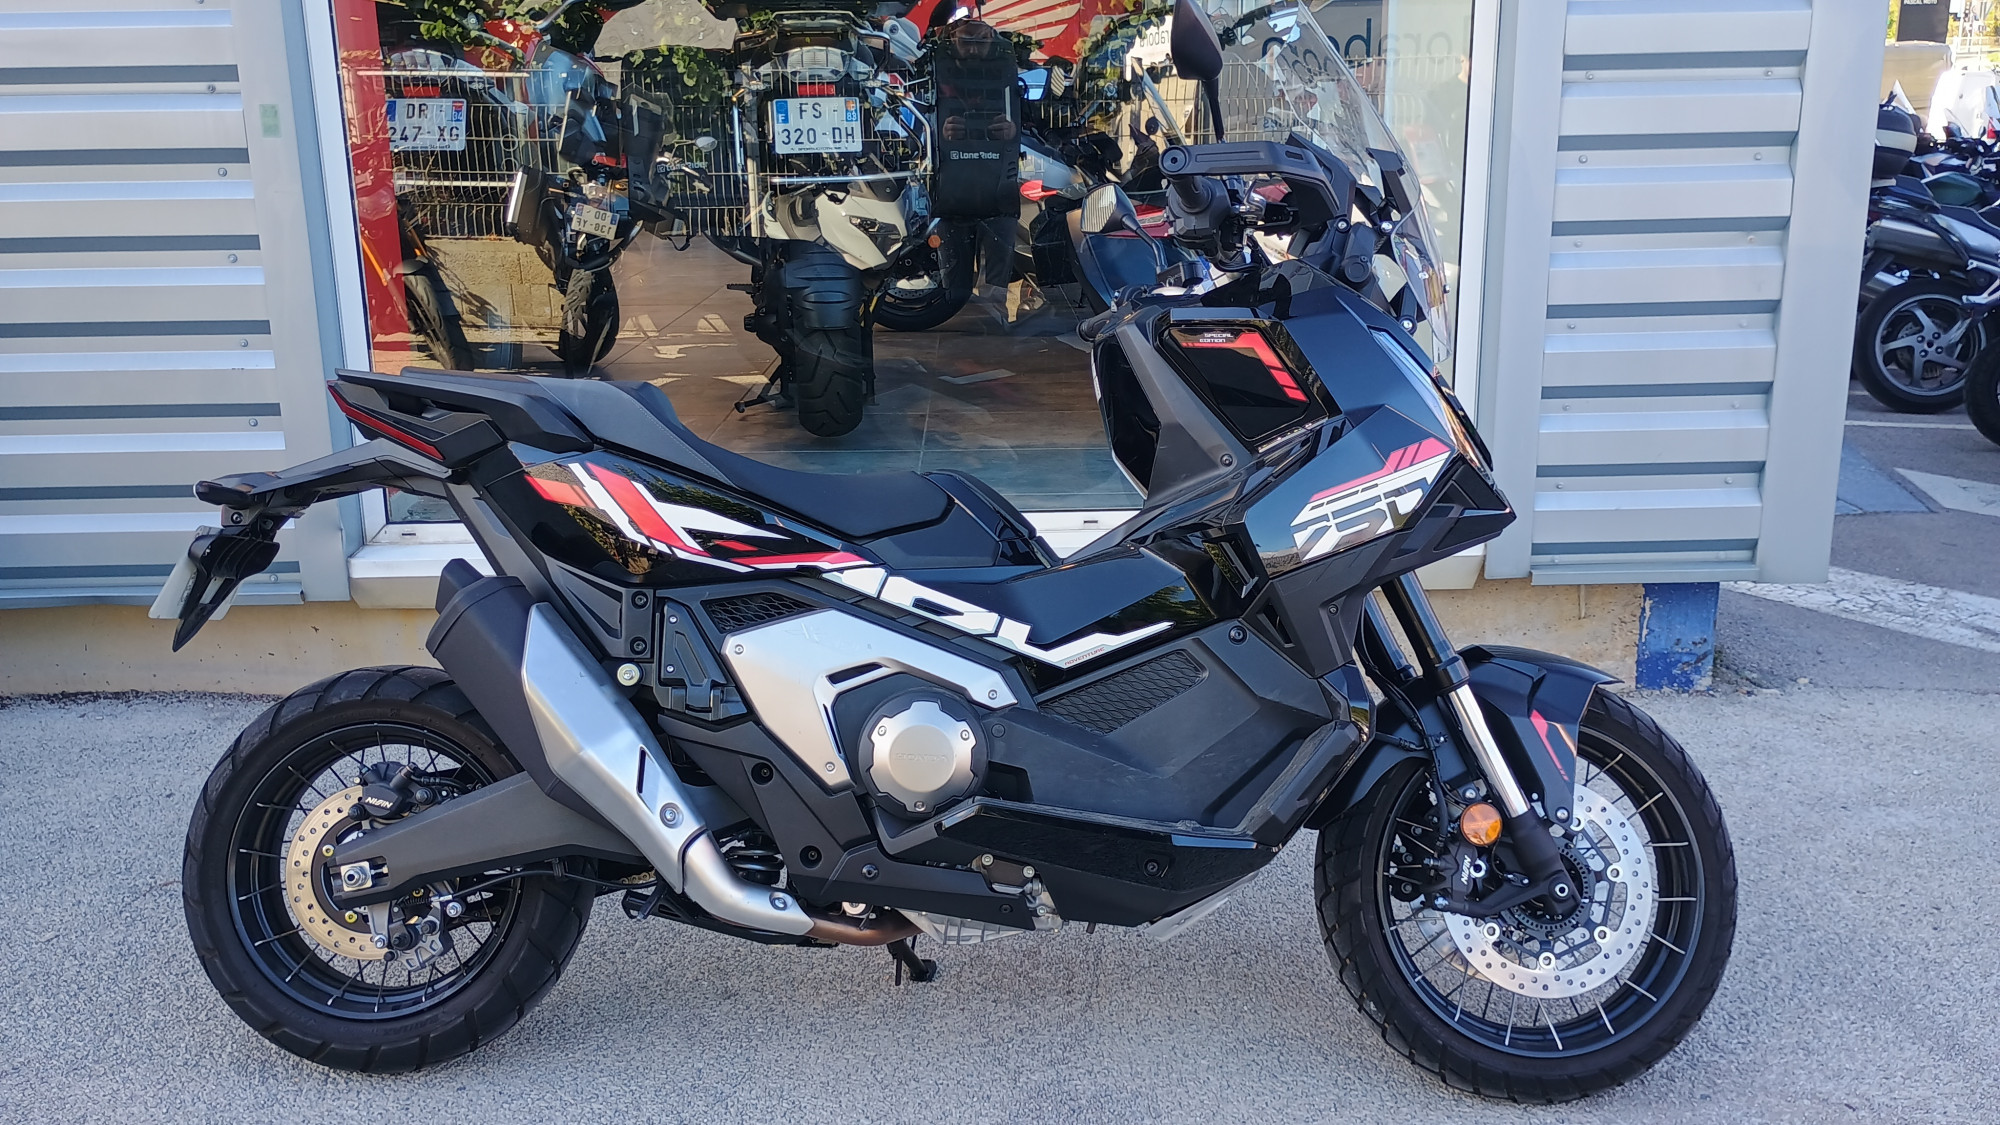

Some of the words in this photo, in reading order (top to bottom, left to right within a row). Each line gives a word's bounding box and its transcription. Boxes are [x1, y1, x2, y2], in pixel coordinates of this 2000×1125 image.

[406, 103, 429, 119] DR
[799, 102, 822, 119] FS
[846, 112, 857, 121] 83
[778, 114, 786, 123] F
[1064, 646, 1105, 666] ADVENTURE
[895, 752, 950, 763] HONDA
